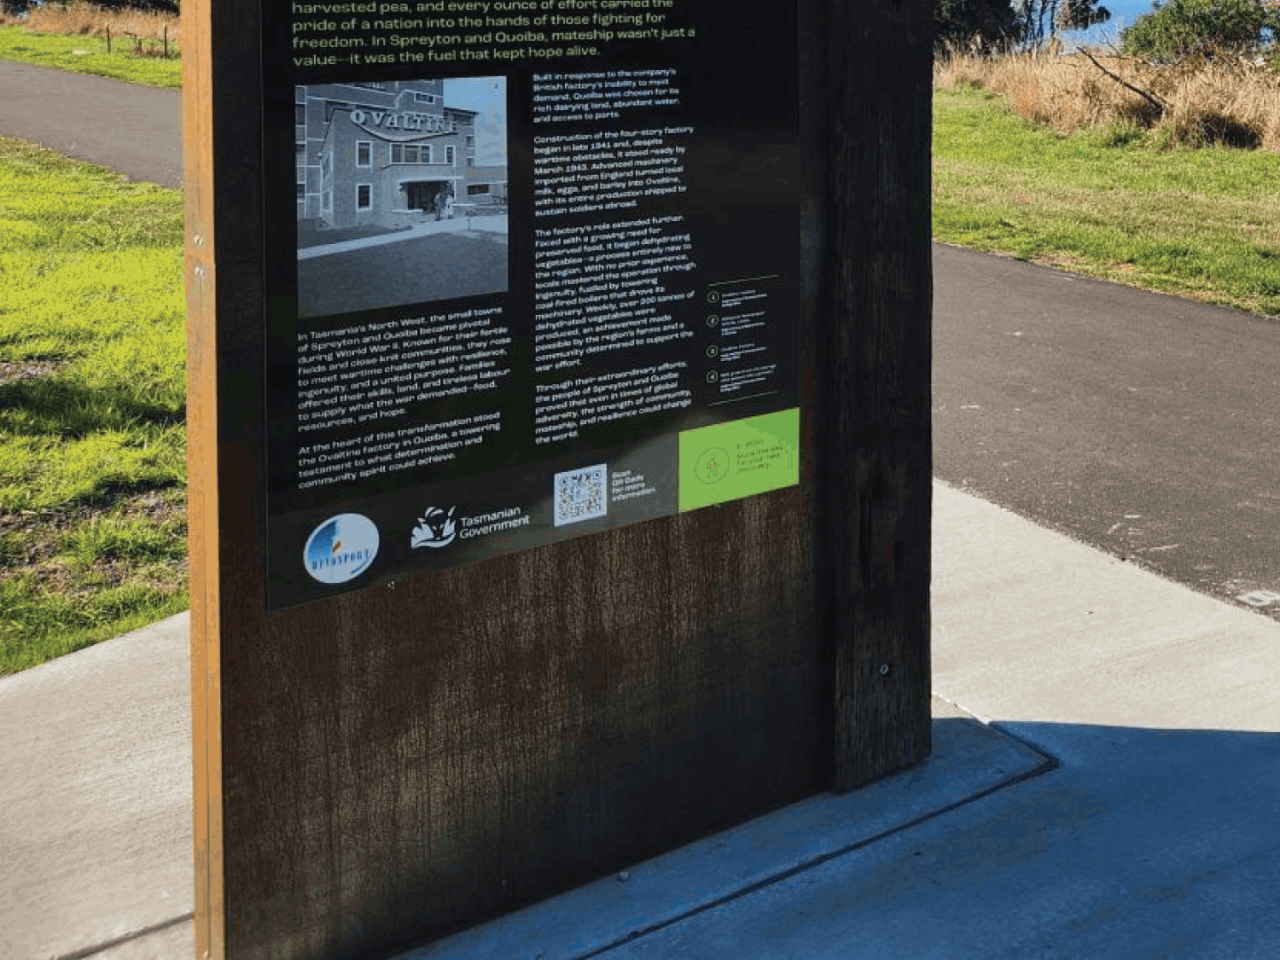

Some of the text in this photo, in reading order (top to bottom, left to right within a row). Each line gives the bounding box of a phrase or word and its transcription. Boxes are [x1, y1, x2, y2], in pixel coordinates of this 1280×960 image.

[292, 2, 376, 13] harvested
[379, 3, 411, 14] pea,
[416, 1, 444, 11] and
[447, 1, 490, 12] every
[493, 1, 537, 10] ounce
[292, 12, 665, 32] pride of a nation into the hands of those fighting for
[371, 35, 385, 46] In
[389, 35, 461, 47] Spreyton
[464, 32, 492, 43] and
[551, 30, 613, 40] mateship
[616, 28, 659, 38] wasn't
[660, 28, 685, 39] just
[687, 28, 695, 37] a
[364, 54, 395, 63] was
[399, 51, 424, 62] the
[427, 49, 456, 61] fuel
[459, 49, 489, 60] that
[493, 48, 525, 60] kept
[528, 47, 563, 58] hope
[566, 45, 600, 56] alive.
[350, 109, 457, 133] OVALTINE
[459, 514, 530, 539] Government
[460, 506, 521, 528] Tasmanian
